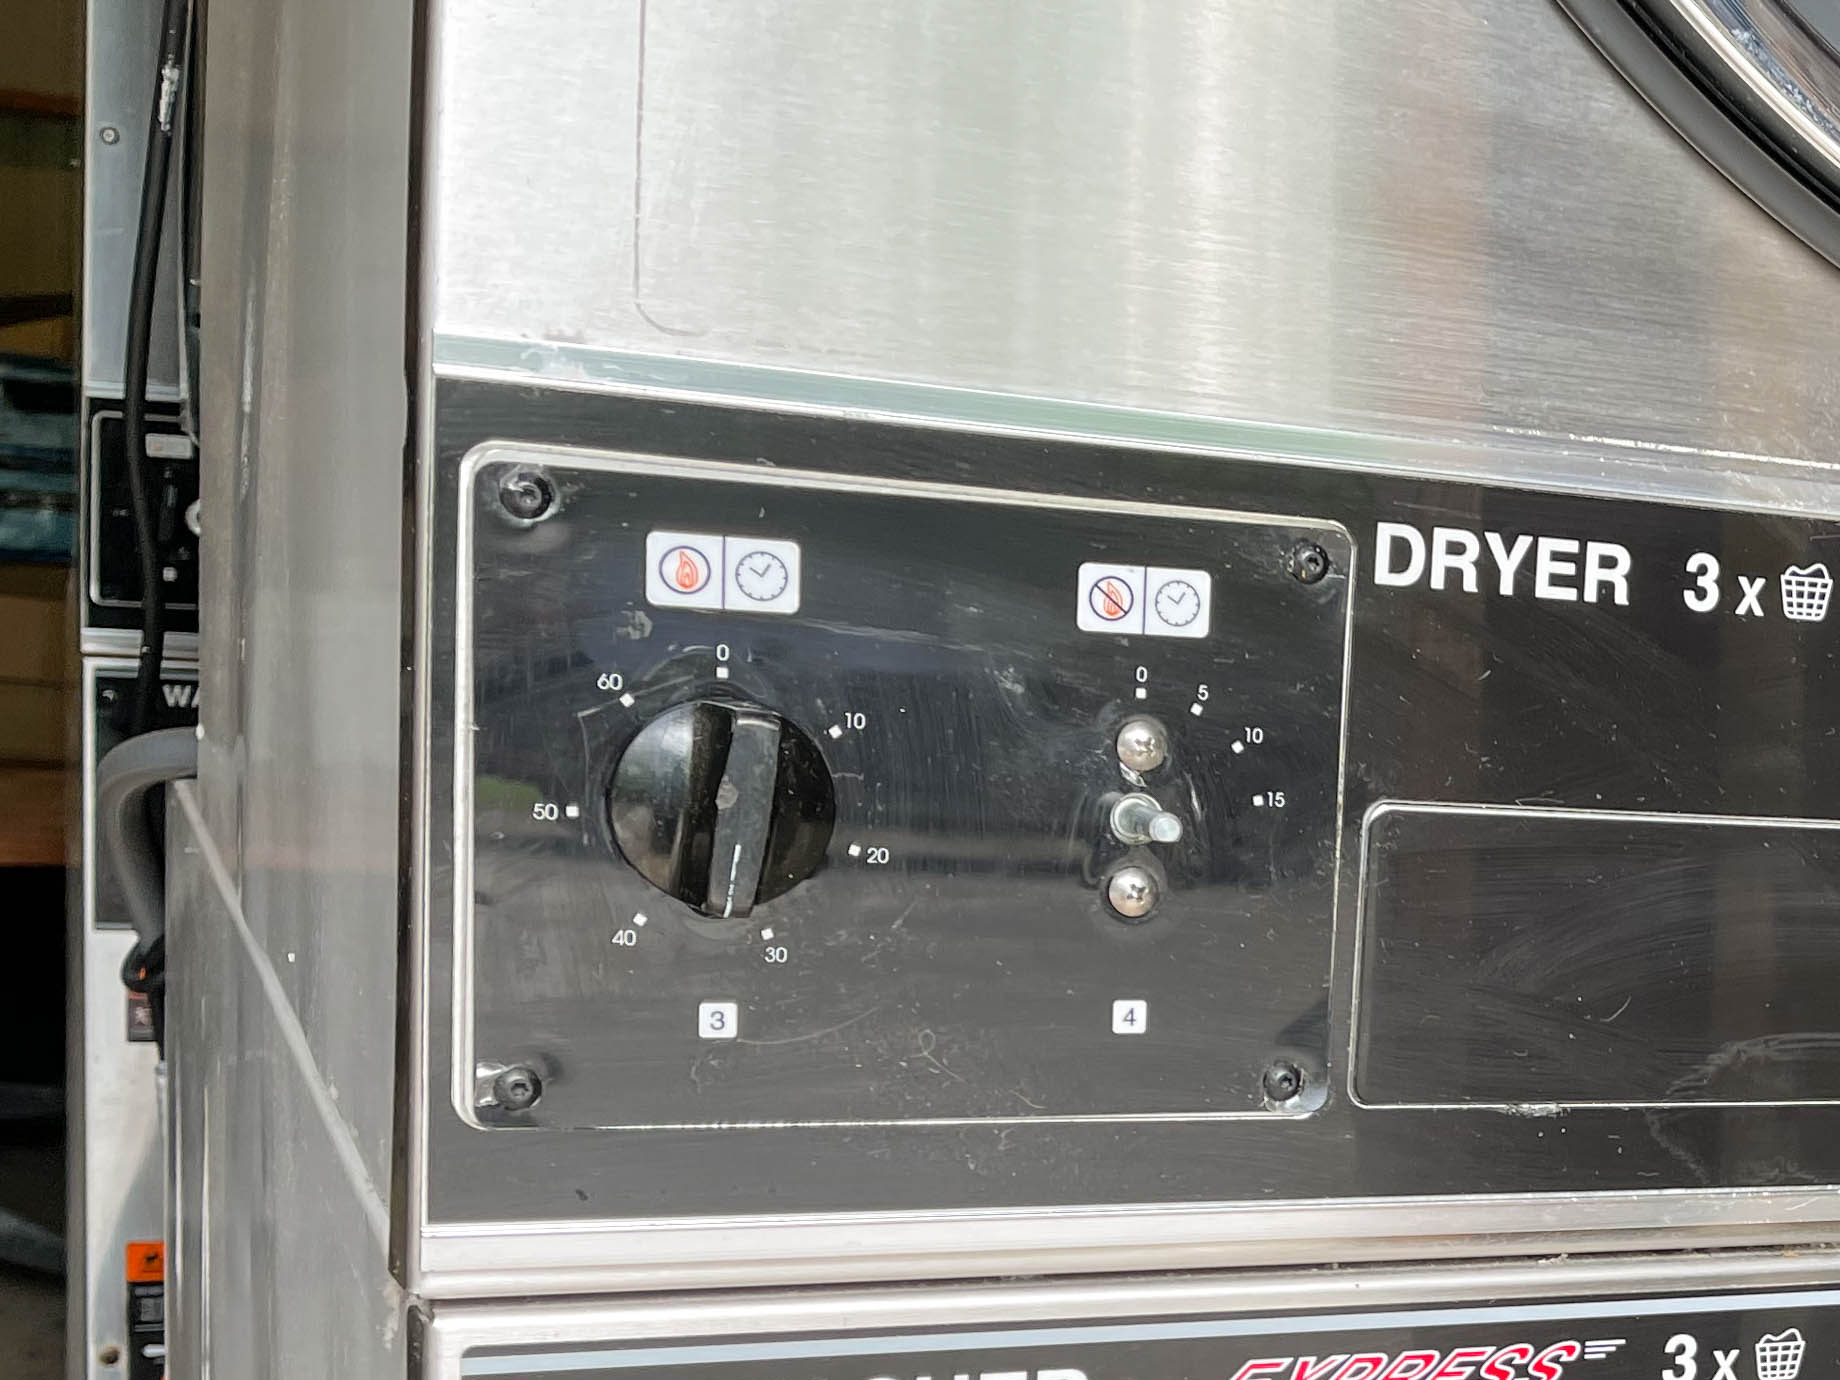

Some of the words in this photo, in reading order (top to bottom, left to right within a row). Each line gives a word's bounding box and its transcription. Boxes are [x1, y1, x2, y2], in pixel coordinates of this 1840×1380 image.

[1374, 522, 1631, 606] DRYER
[1683, 552, 1720, 612] 3
[716, 644, 730, 662] 0
[597, 672, 623, 692] 60
[1135, 667, 1148, 683] 0
[1197, 685, 1210, 703] 5
[845, 712, 867, 731] 10
[1245, 727, 1265, 746] 10
[1267, 791, 1287, 809] 15
[532, 803, 559, 821] 50
[867, 847, 890, 865] 20
[611, 929, 637, 948] 40
[764, 946, 789, 964] 30
[709, 1011, 726, 1032] 3
[1121, 1008, 1138, 1028] 4
